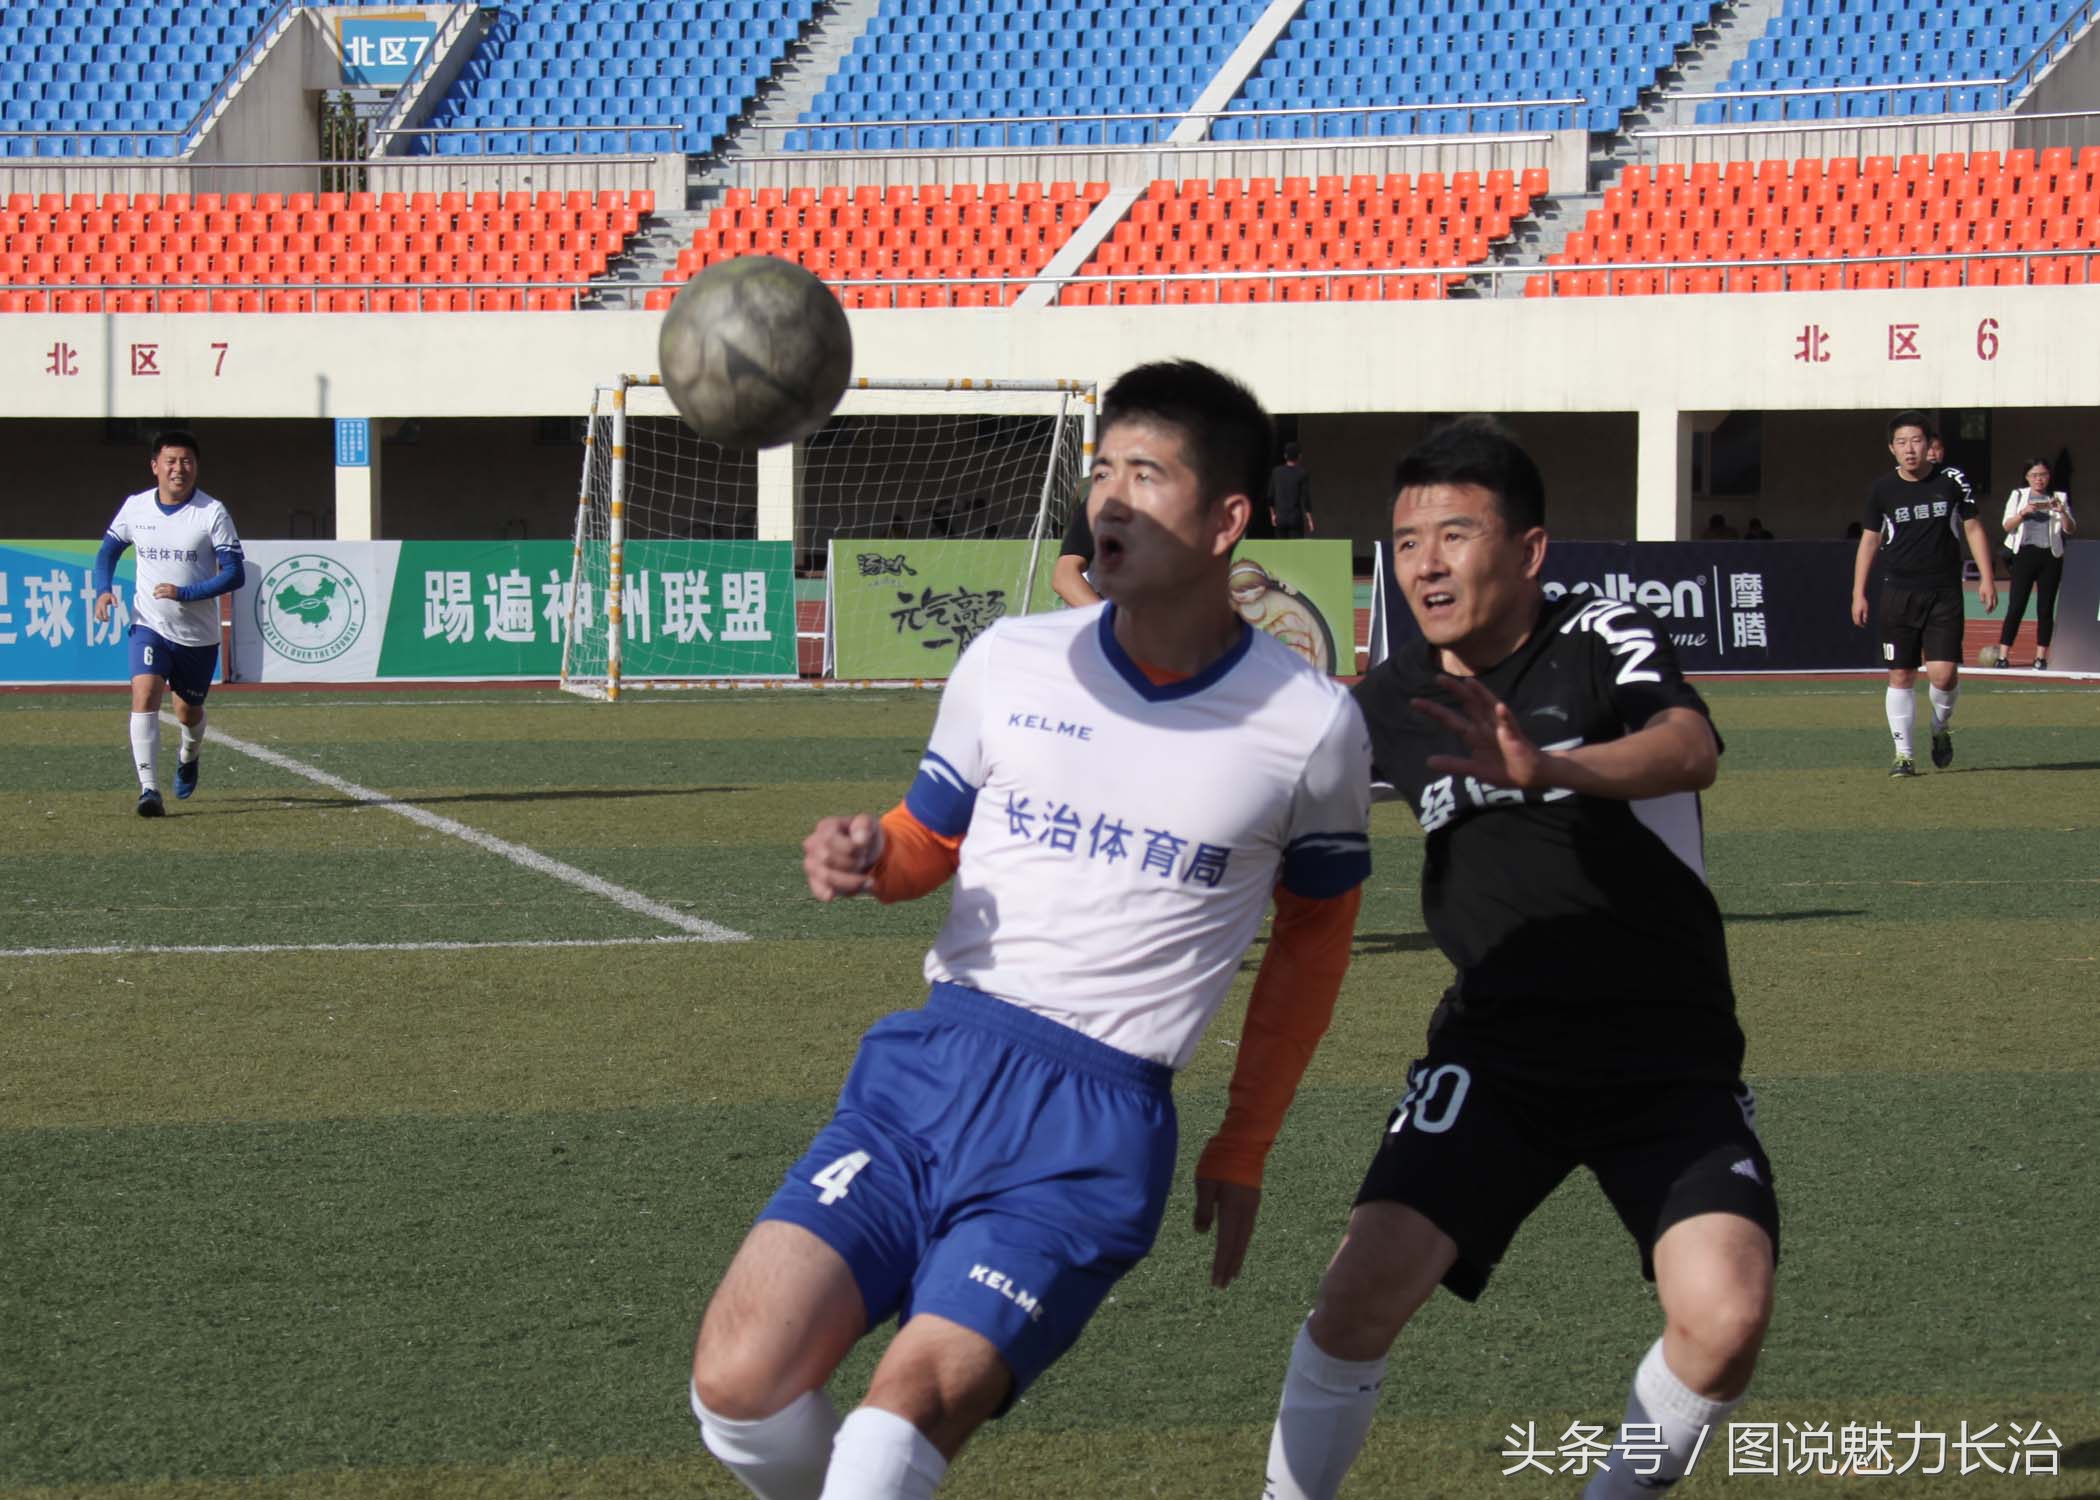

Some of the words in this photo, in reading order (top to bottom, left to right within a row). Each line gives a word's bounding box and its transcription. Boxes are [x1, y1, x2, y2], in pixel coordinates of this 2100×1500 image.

[345, 36, 430, 66] 北区7
[138, 546, 198, 562] 长治体育局
[422, 568, 772, 644] 踢遍神州联盟
[1729, 572, 1768, 648] 摩腾
[143, 646, 154, 666] 6
[1008, 712, 1094, 742] KELME
[1005, 791, 1232, 889] 长治体育局
[810, 1150, 872, 1206] 4
